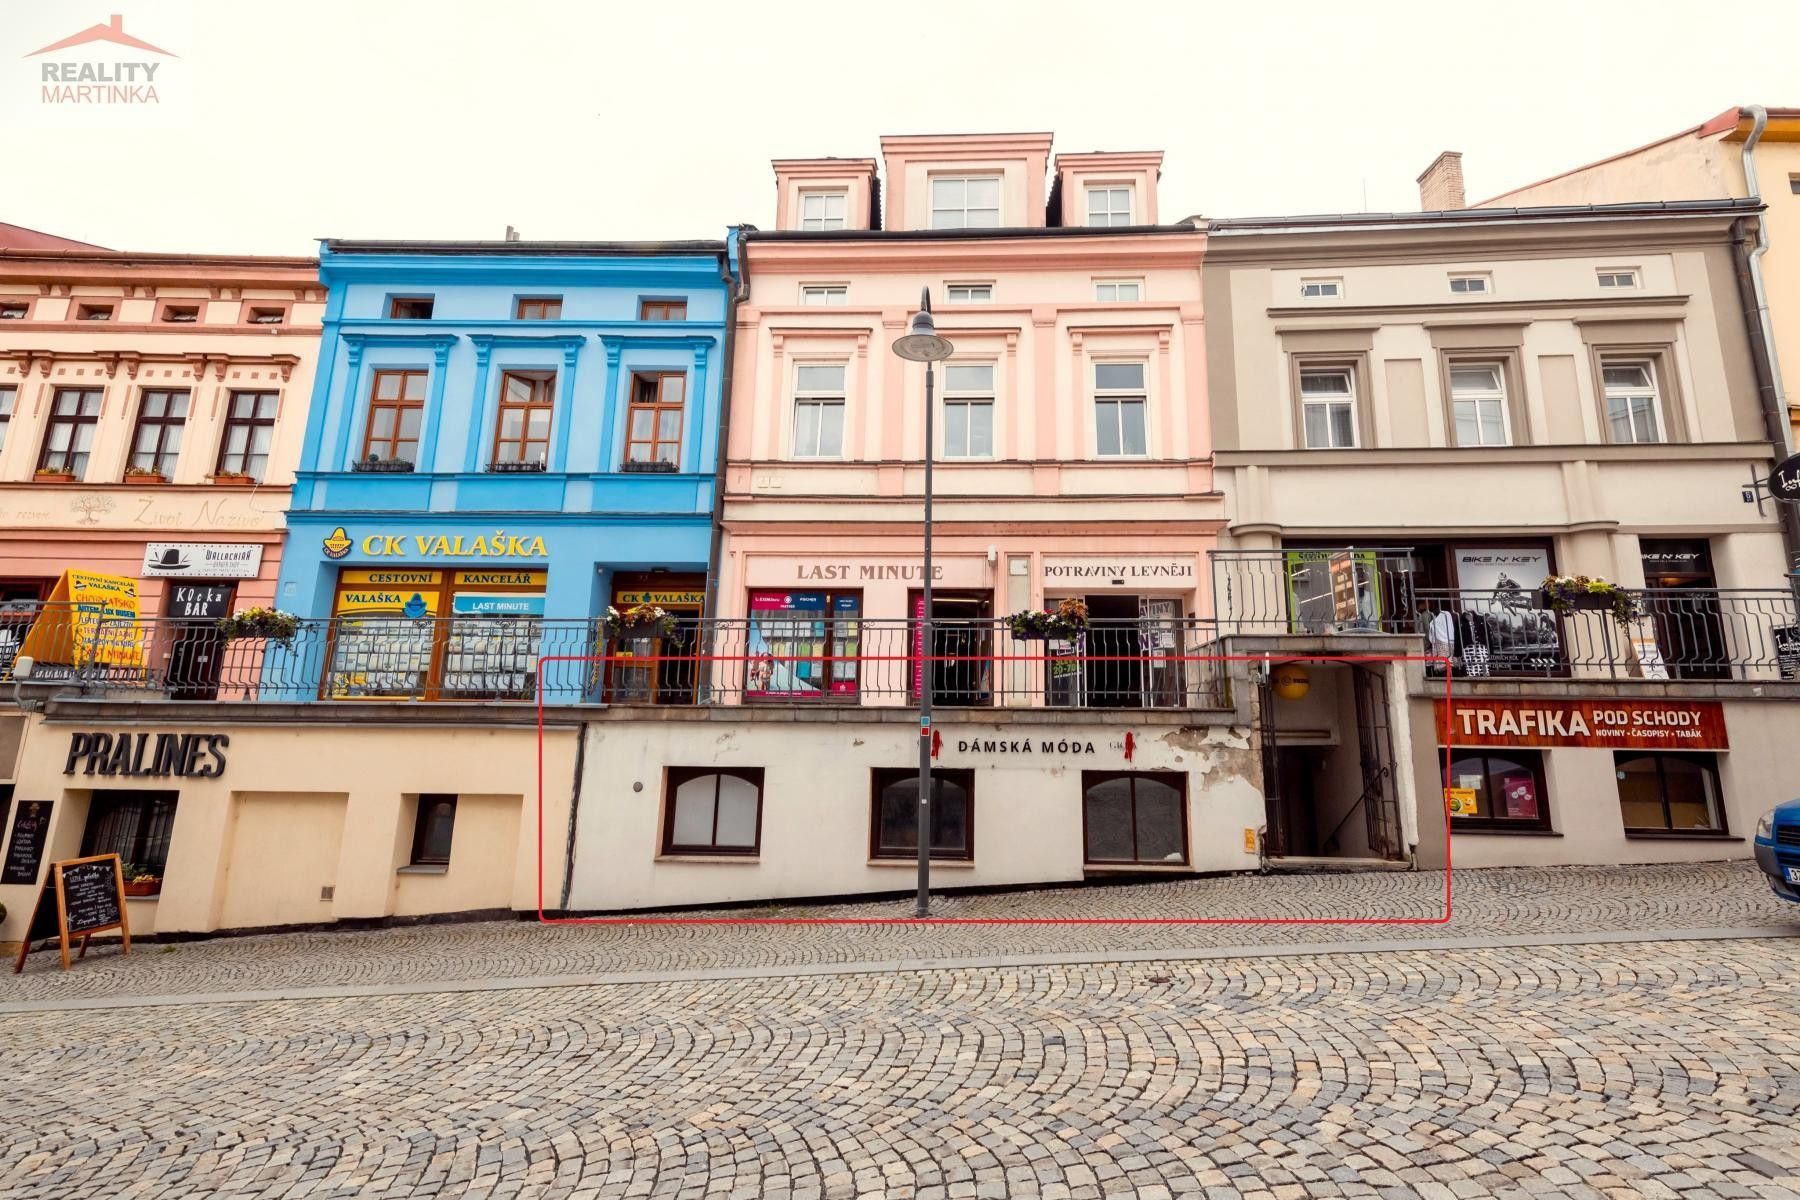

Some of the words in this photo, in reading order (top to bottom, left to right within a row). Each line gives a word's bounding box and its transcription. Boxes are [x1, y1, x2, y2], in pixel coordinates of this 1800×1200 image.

[362, 535, 407, 556] CK
[415, 530, 548, 557] VALAŠKA
[369, 572, 433, 584] CESTOVNÍ
[463, 572, 532, 584] KANCELÁŘ
[797, 564, 850, 580] LAST
[859, 565, 943, 581] MINUTE
[1044, 565, 1127, 578] POTRAVINY
[1131, 562, 1193, 578] LEVNĚJI
[345, 591, 402, 603] VALAŠKA
[623, 594, 639, 603] CK
[654, 592, 706, 603] VALAŠKA
[184, 602, 209, 616] BAR
[472, 601, 495, 611] LAST
[496, 602, 529, 611] MINUTE
[1456, 709, 1591, 737] TRAFIKA
[1593, 710, 1629, 726] POD
[1632, 710, 1702, 726] SCHODY
[1595, 729, 1626, 738] NOVINY
[1631, 727, 1670, 738] ČASOPISY
[1675, 728, 1703, 738] TABÁK
[957, 738, 1033, 753] DÁMSKÁ
[1041, 738, 1096, 754] MÓDA
[62, 732, 230, 778] PRALINES
